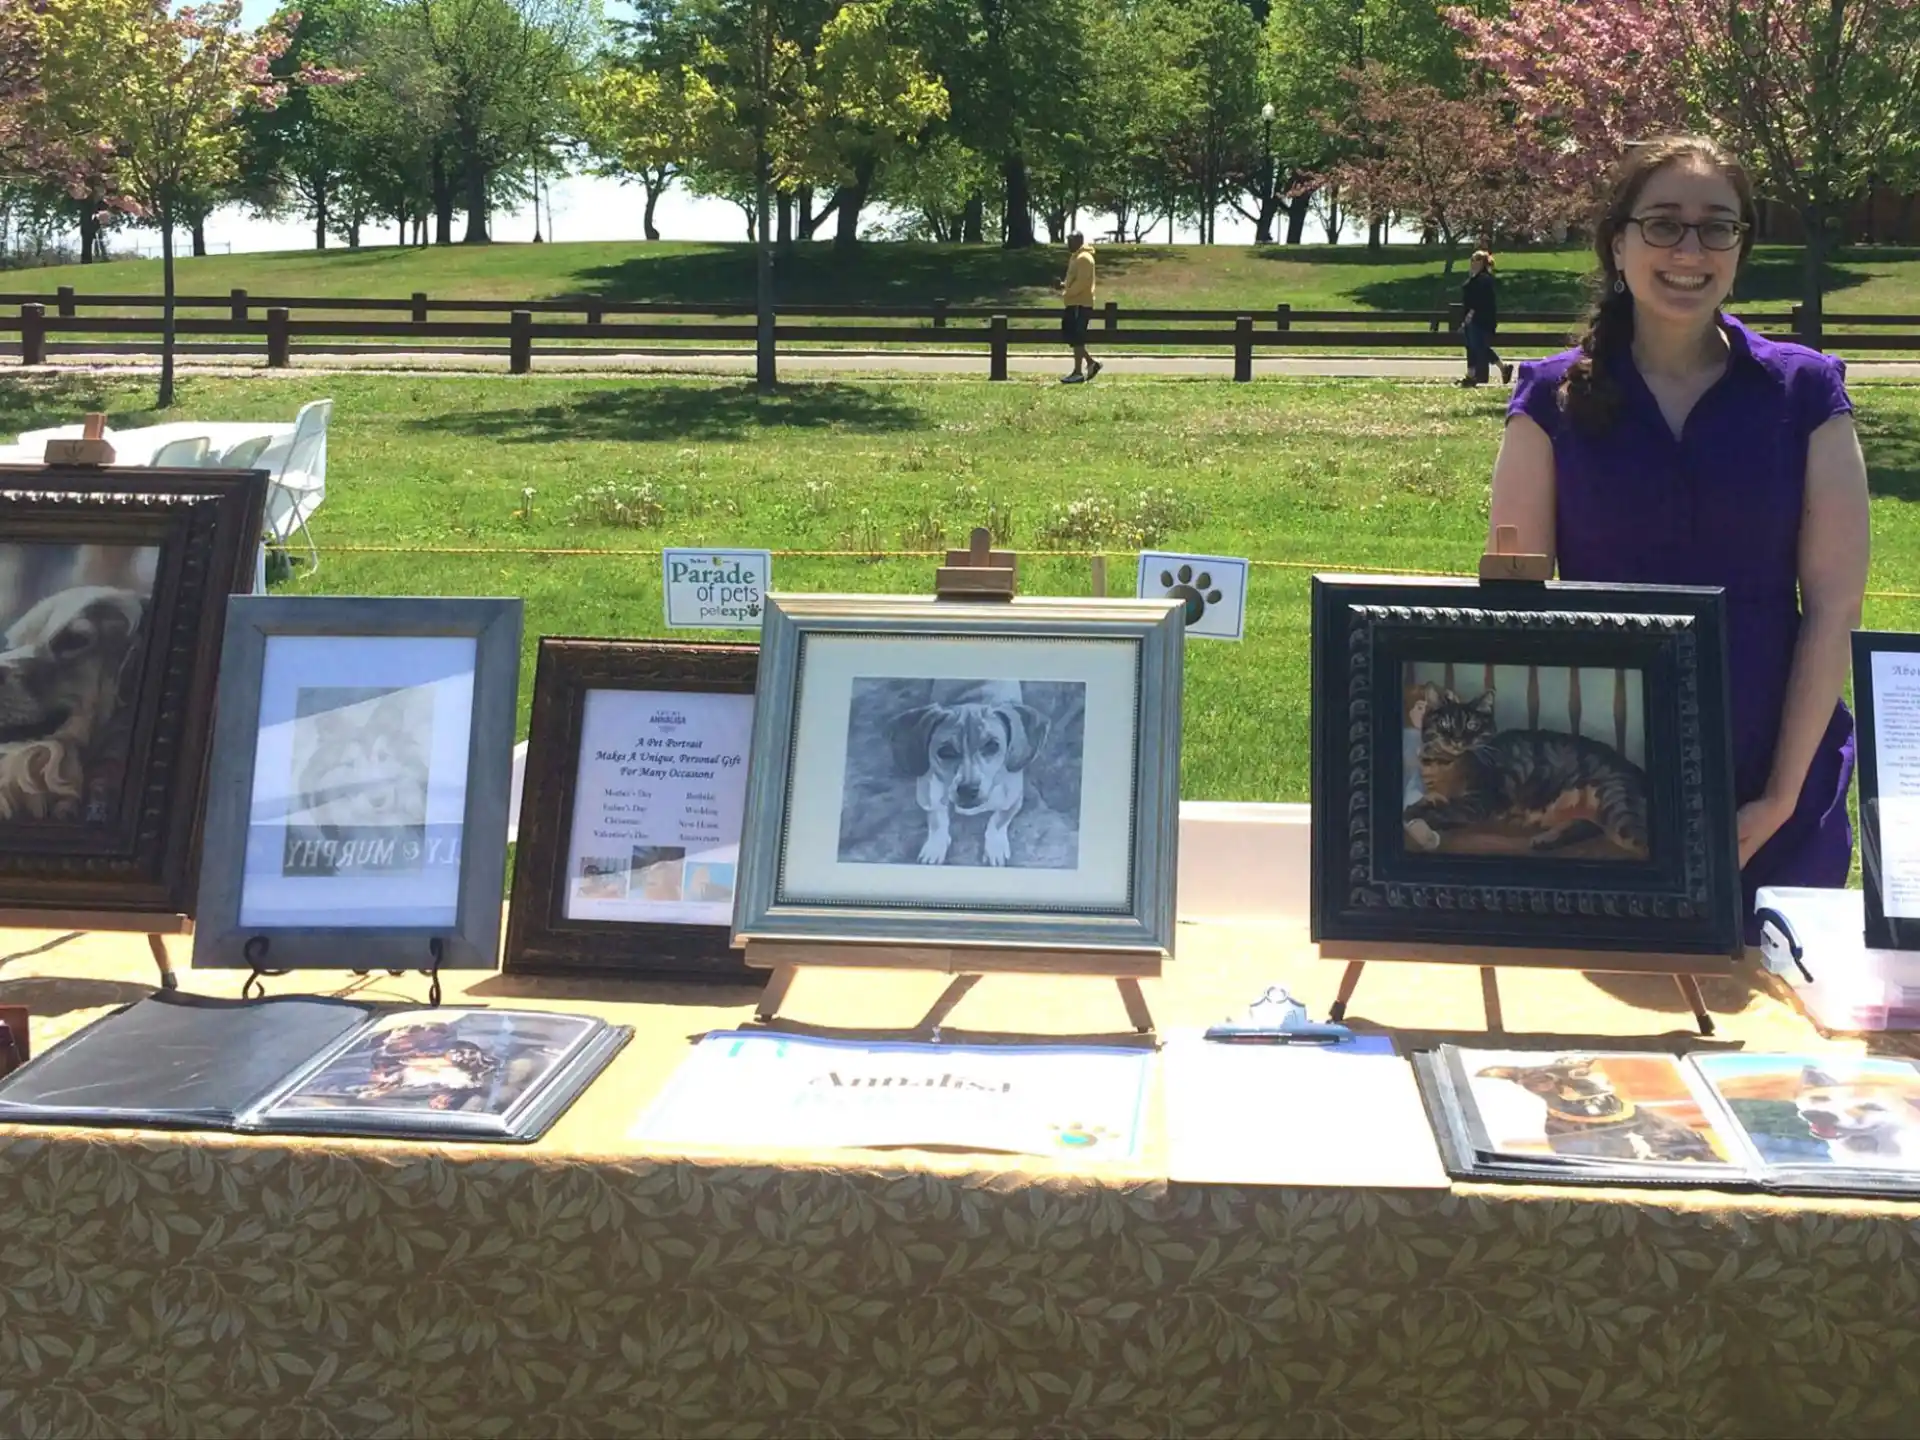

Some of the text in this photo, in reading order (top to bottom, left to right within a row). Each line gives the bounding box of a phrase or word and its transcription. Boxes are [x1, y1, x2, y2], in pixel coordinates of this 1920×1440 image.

[671, 562, 756, 584] Parade
[697, 583, 760, 606] of pets
[634, 738, 703, 750] A Pet Portrait
[594, 750, 626, 762] Makes
[626, 751, 638, 763] A
[678, 753, 723, 766] Personal
[720, 755, 742, 769] Gift
[620, 766, 637, 778] For
[637, 767, 669, 781] Many
